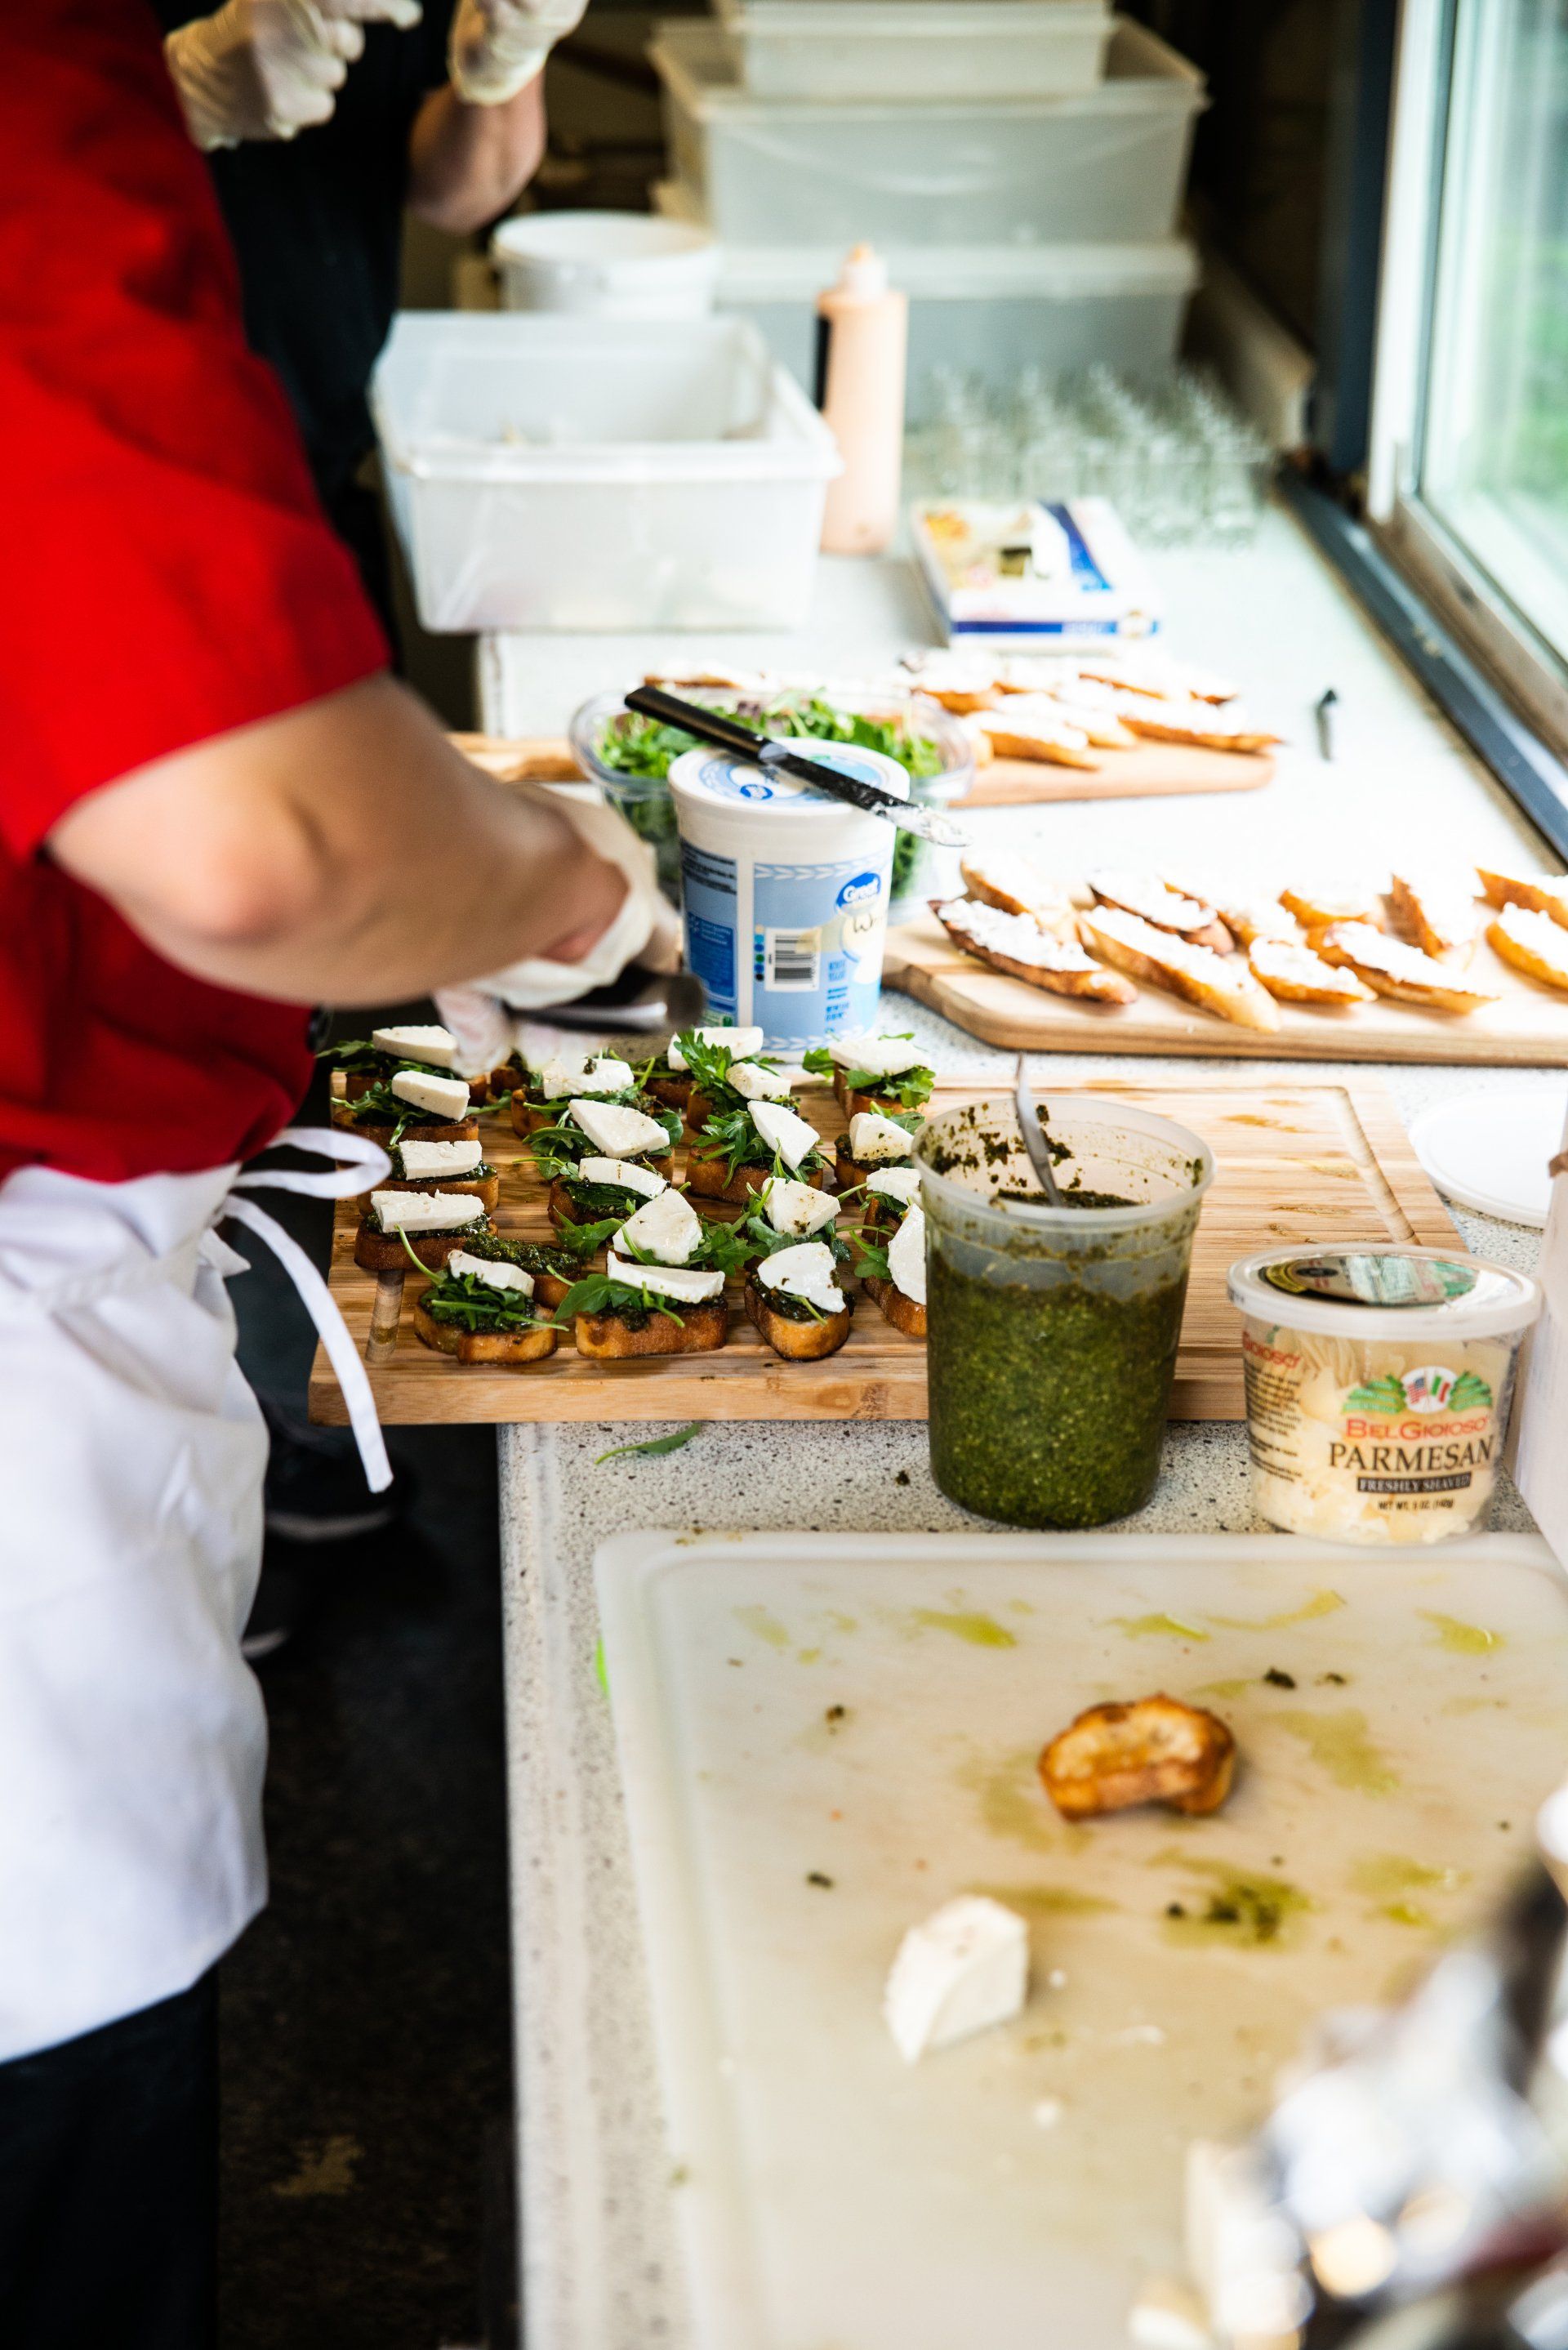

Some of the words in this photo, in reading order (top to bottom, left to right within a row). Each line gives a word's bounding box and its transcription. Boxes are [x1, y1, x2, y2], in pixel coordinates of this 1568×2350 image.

[1330, 1434, 1494, 1471] PARMESAN
[1360, 1477, 1419, 1492] FRESHLY
[1423, 1471, 1471, 1489] SHAVED
[1378, 1500, 1394, 1510] NET
